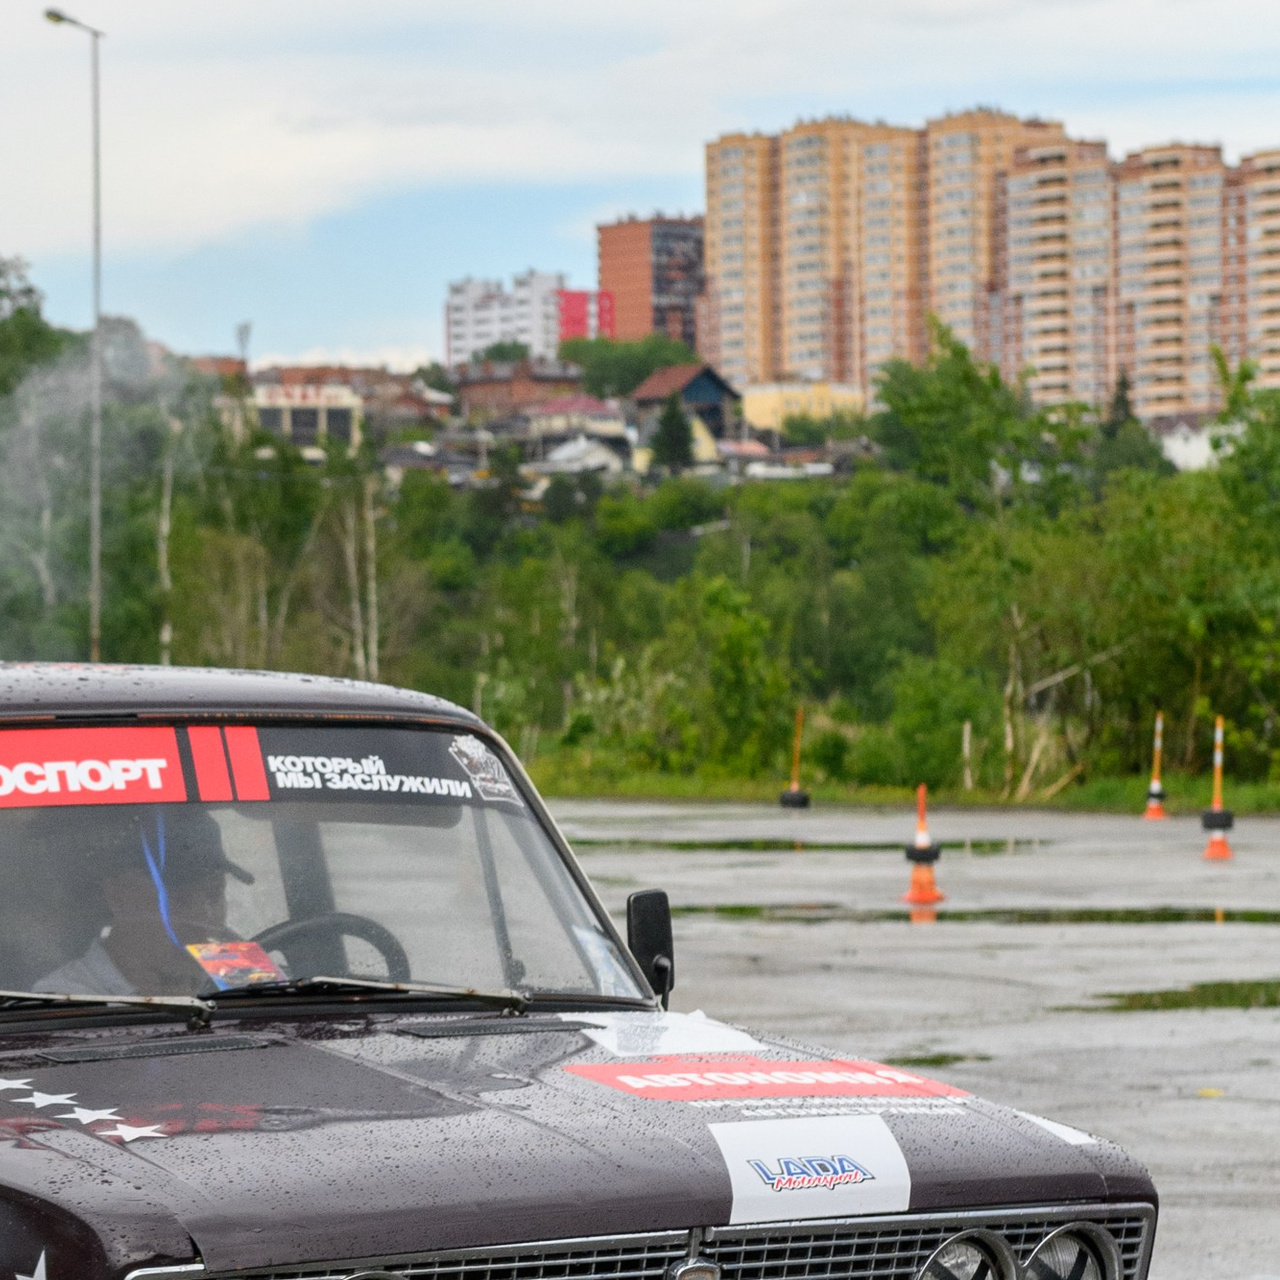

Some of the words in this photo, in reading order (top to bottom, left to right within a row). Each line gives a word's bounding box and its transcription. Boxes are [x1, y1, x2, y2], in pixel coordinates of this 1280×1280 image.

[267, 755, 387, 776] КОТОРЫЙ
[276, 772, 321, 790] МЫ
[326, 773, 473, 798] ЗАСЛУЖИЛИ
[616, 1070, 924, 1088] АВТОНОМИЯ
[747, 1154, 876, 1184] LADA
[773, 1171, 862, 1191] Motorsport
